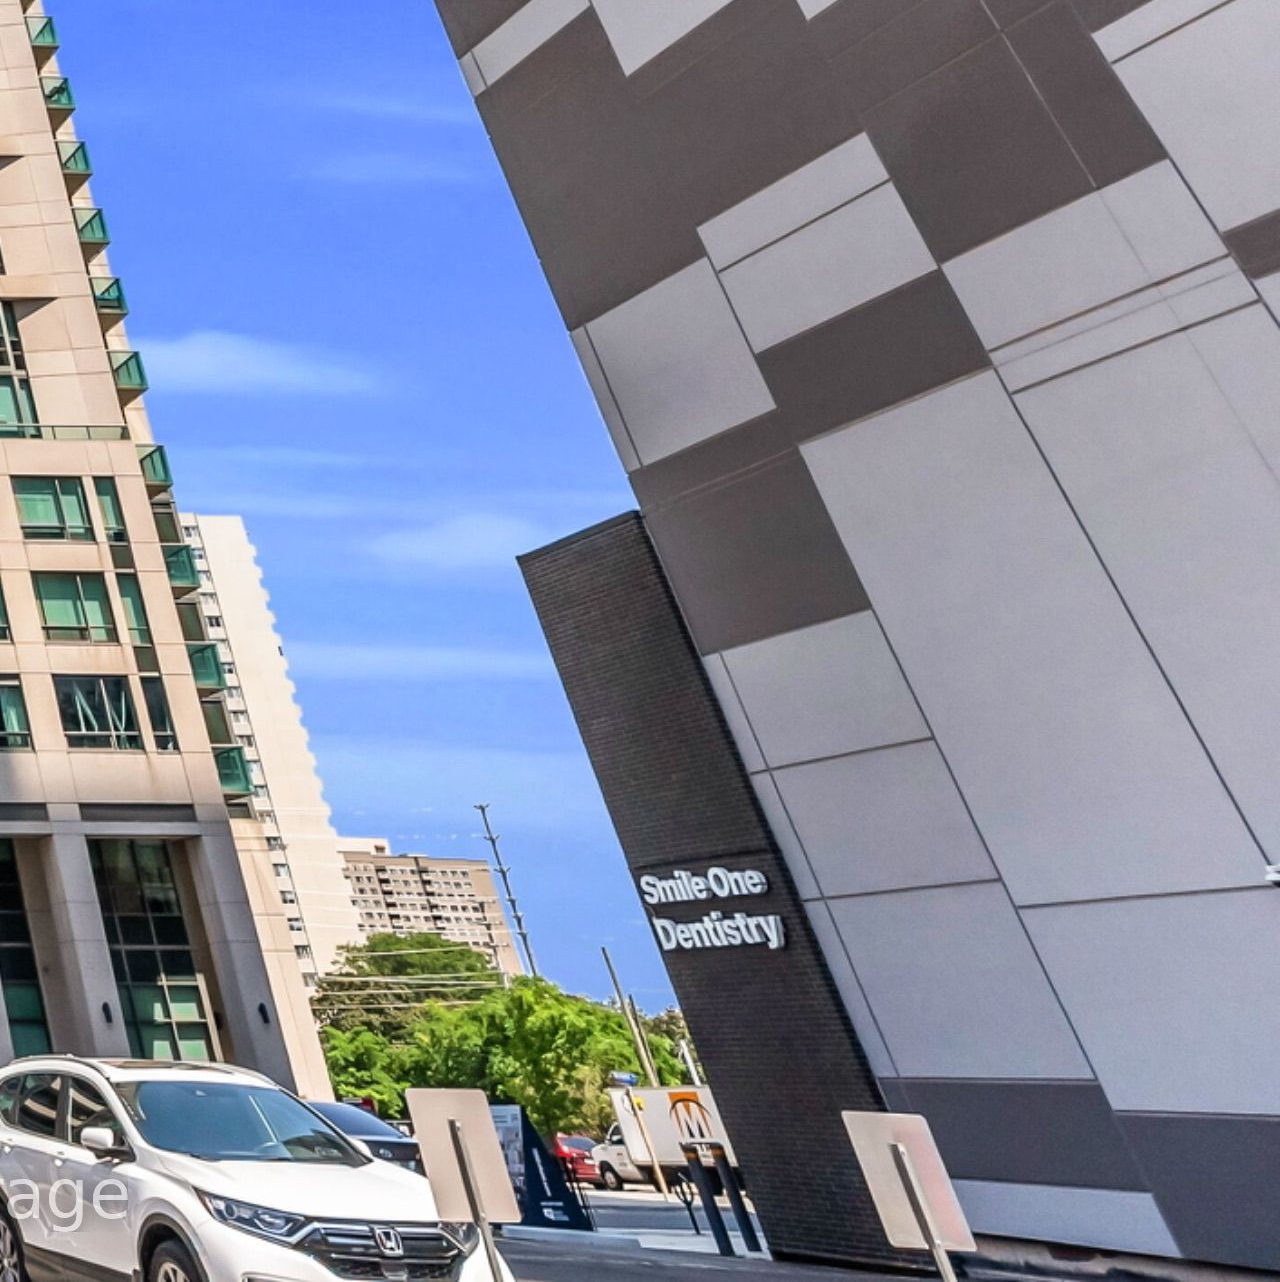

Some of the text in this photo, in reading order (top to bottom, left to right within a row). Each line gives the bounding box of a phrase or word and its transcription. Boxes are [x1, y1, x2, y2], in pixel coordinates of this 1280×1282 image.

[640, 867, 768, 905] Smile One
[653, 911, 785, 950] Dentistry
